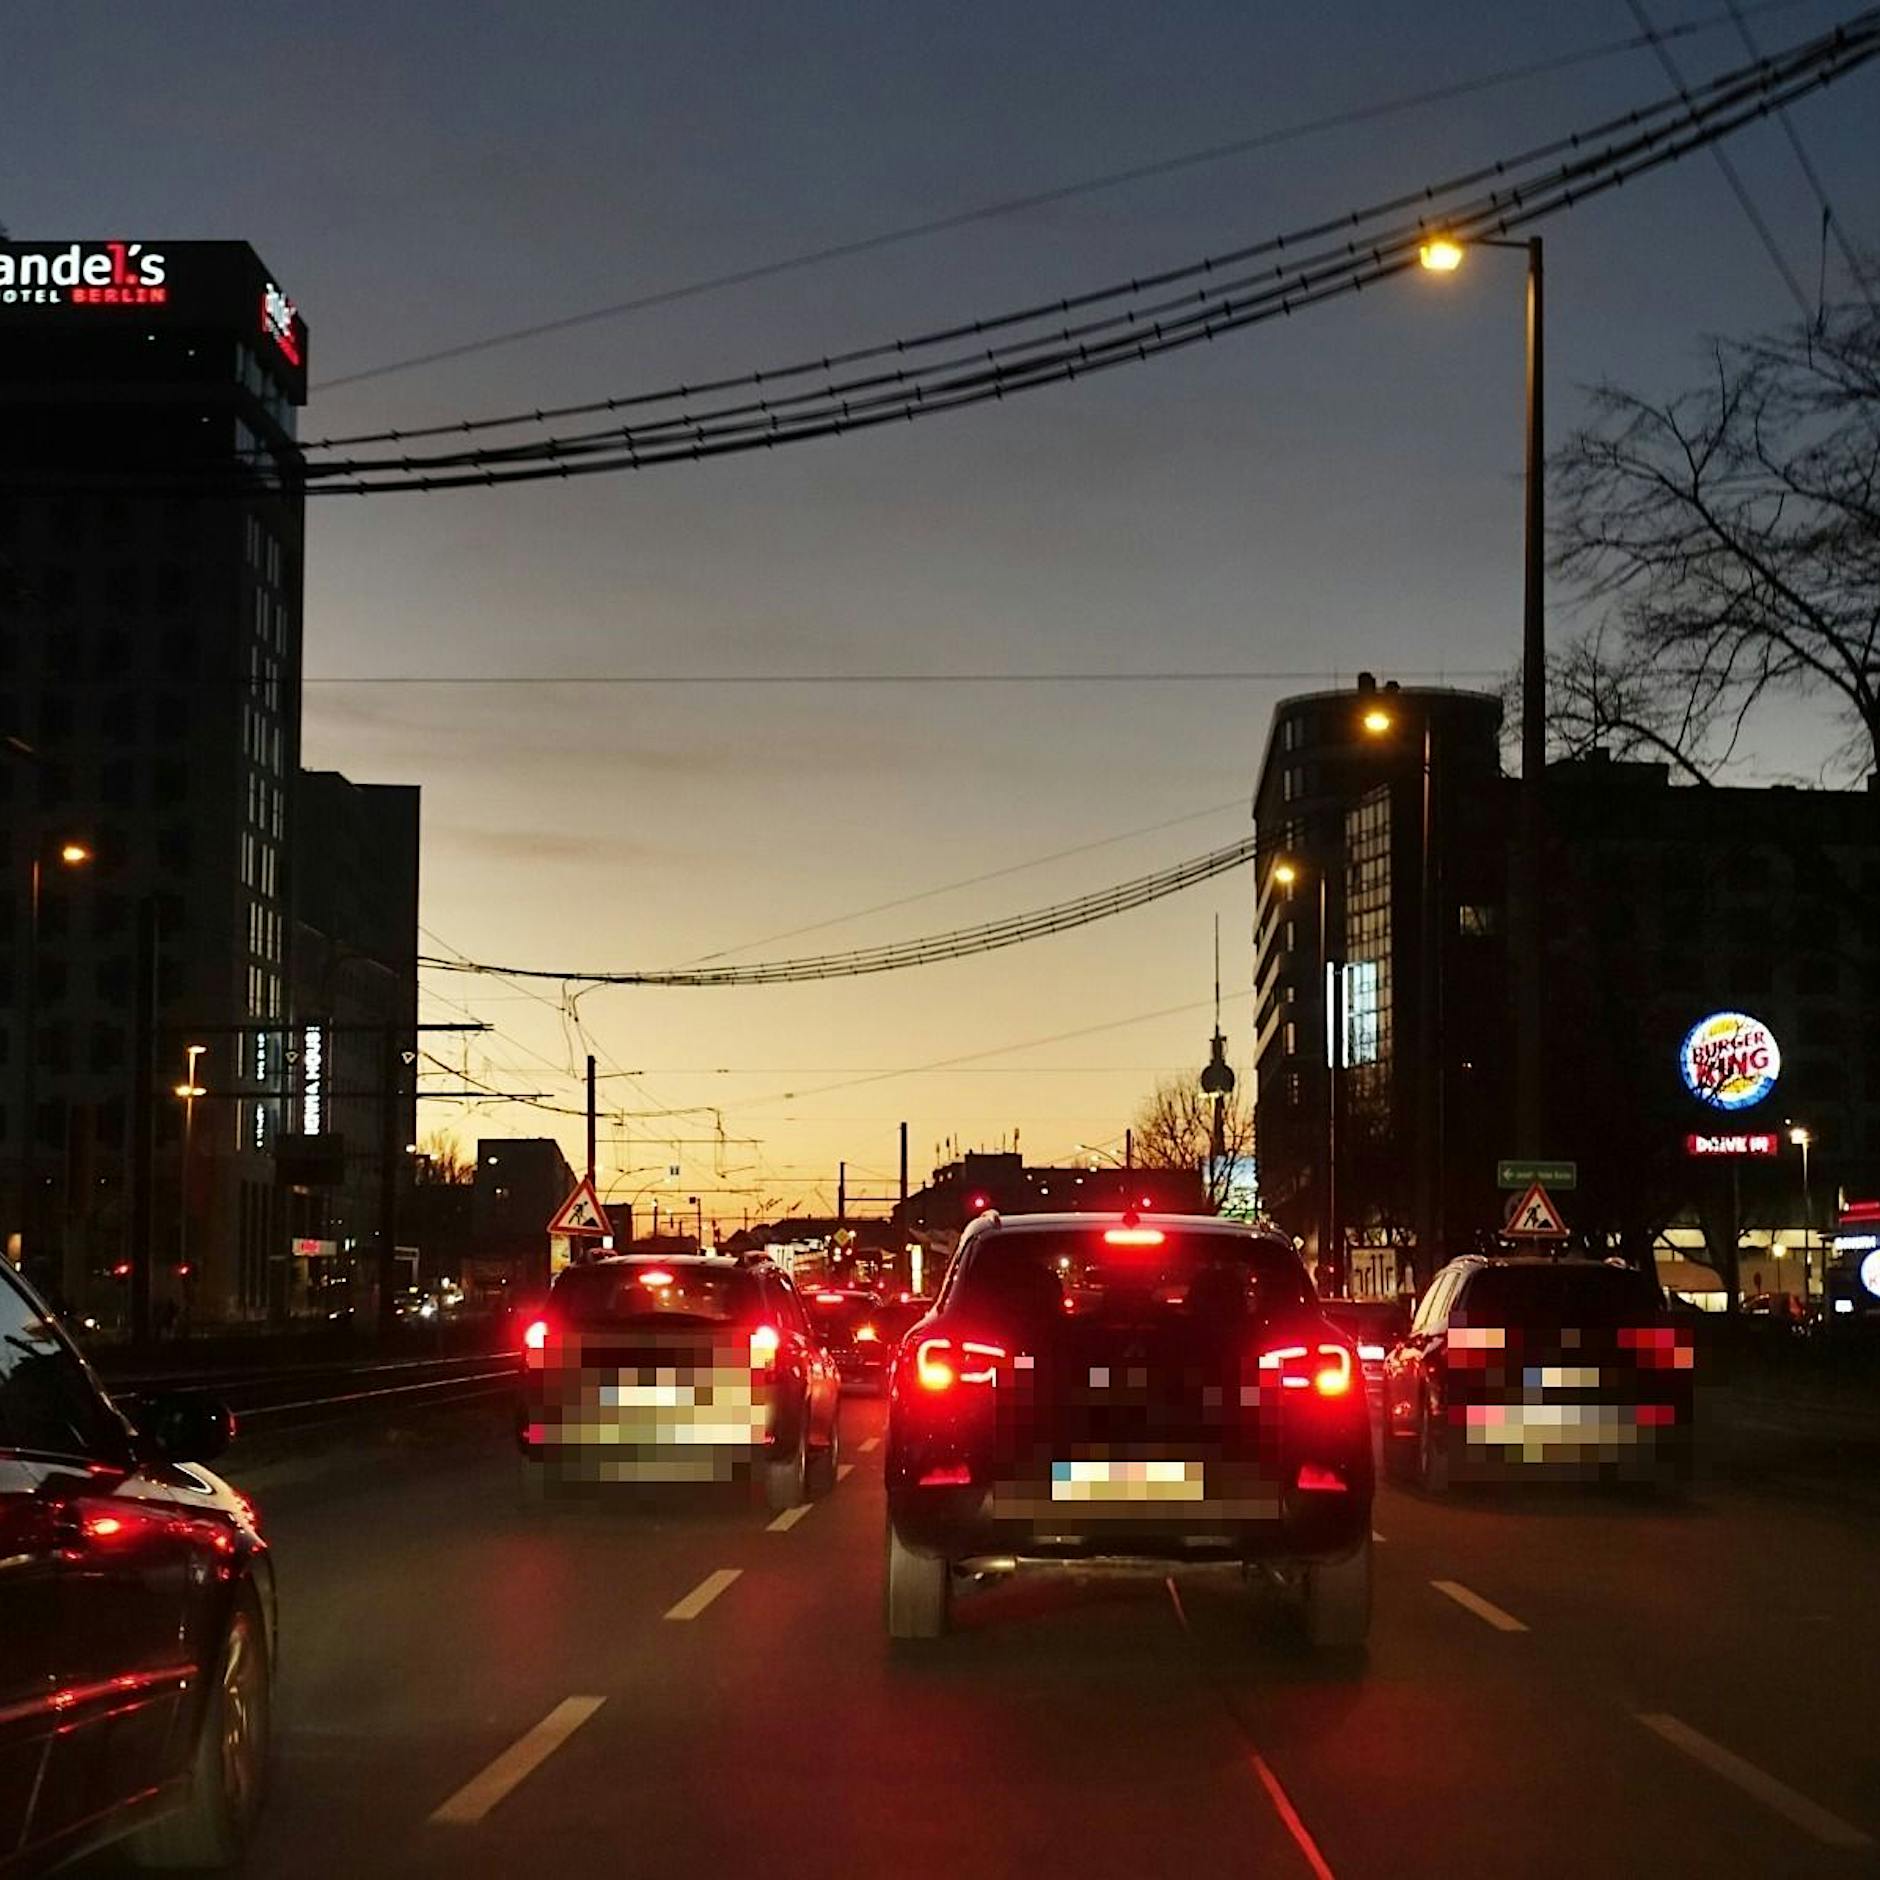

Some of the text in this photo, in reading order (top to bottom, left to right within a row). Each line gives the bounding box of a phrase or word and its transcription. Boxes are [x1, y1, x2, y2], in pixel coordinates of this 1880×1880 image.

[0, 288, 167, 304] OTEL BERLIN
[1692, 1031, 1765, 1065] BURGER
[1696, 1047, 1769, 1087] KING
